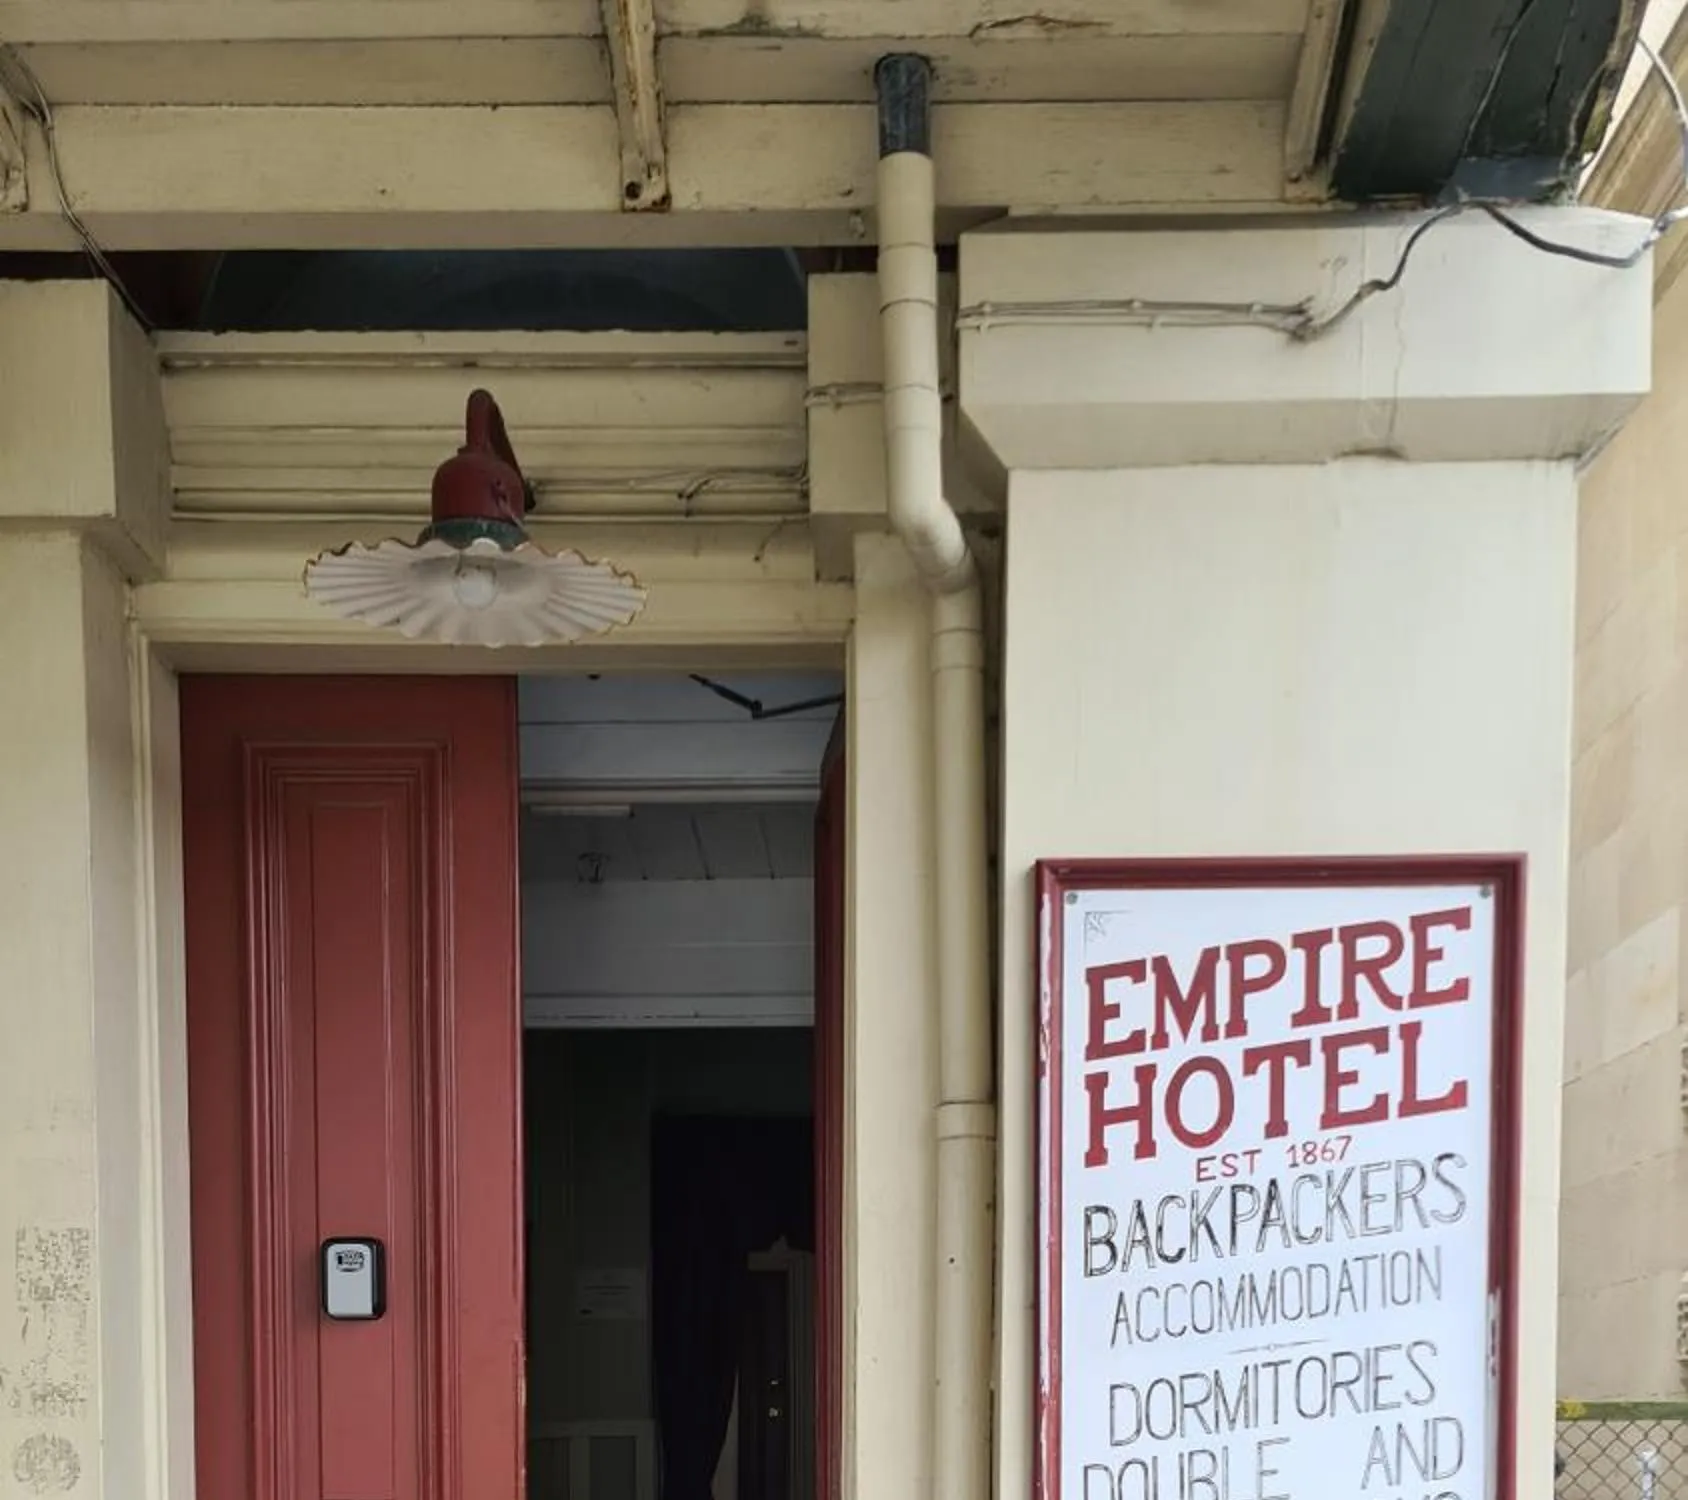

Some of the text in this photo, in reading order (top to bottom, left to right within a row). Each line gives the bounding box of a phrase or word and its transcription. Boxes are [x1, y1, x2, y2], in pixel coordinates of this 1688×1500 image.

[1084, 906, 1472, 1062] EMPIRE
[1084, 1021, 1469, 1169] HOTEL
[1195, 1135, 1353, 1183] EST 1867
[1083, 1152, 1468, 1278] BACKPACKERS
[1110, 1246, 1442, 1349] ACCOMMODATION
[1109, 1340, 1438, 1447] DORMITORIES
[1360, 1416, 1466, 1491] AND
